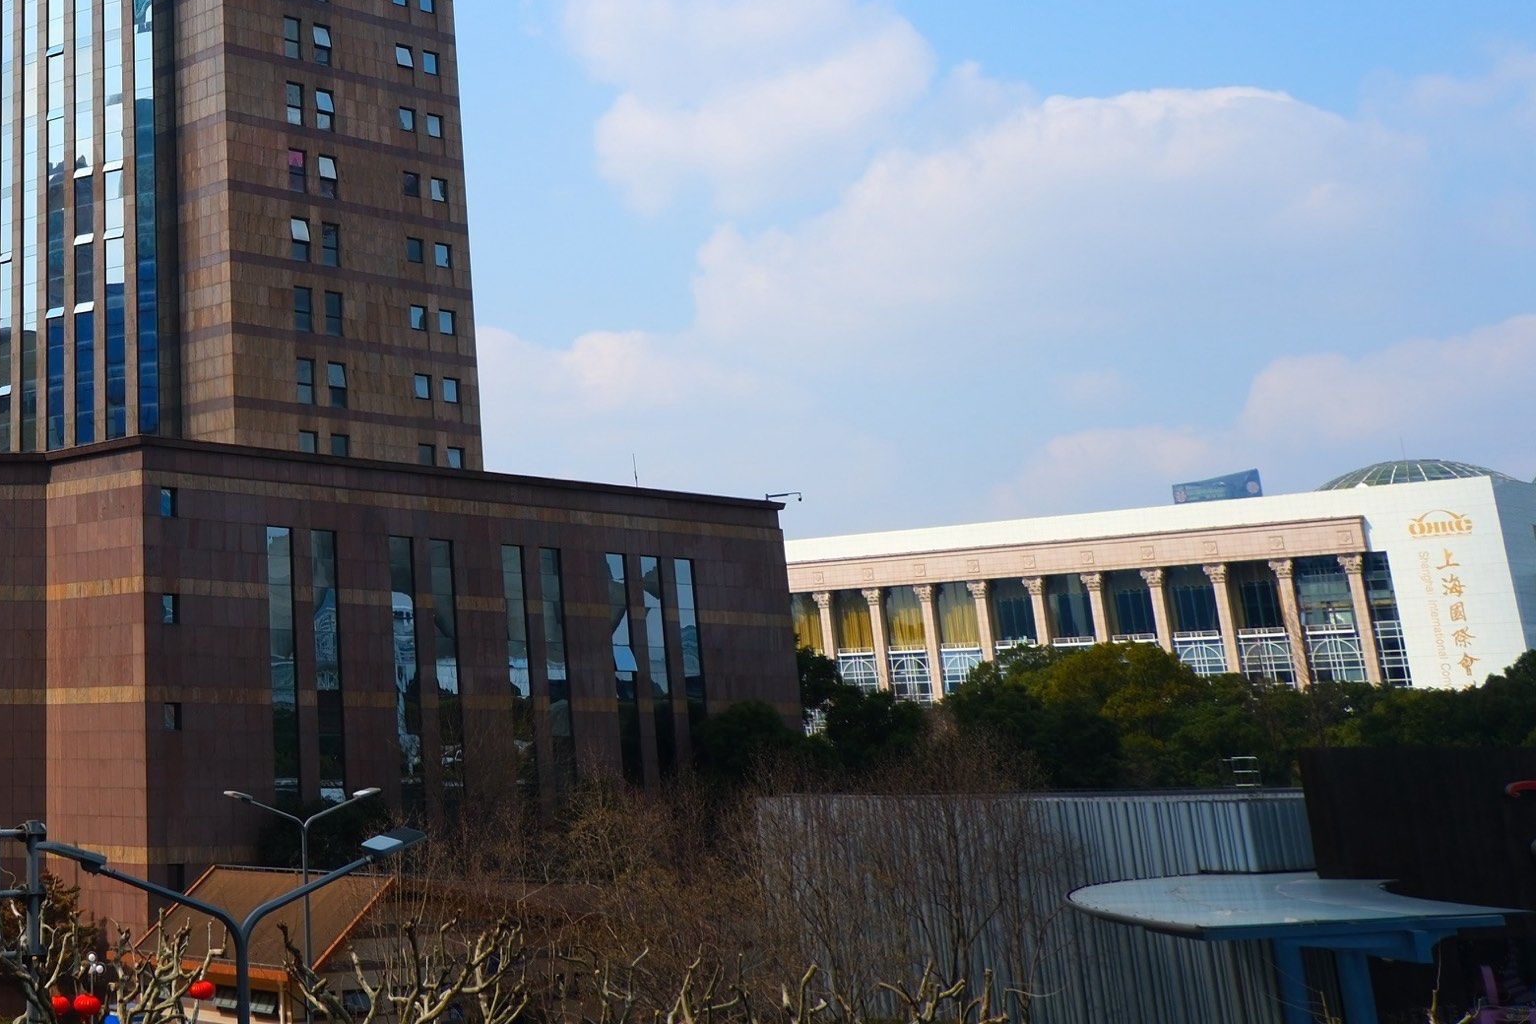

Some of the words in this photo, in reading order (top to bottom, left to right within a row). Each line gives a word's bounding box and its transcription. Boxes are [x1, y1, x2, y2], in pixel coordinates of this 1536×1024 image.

[1427, 599, 1448, 660] International
[1436, 548, 1480, 689] 上海國際會
